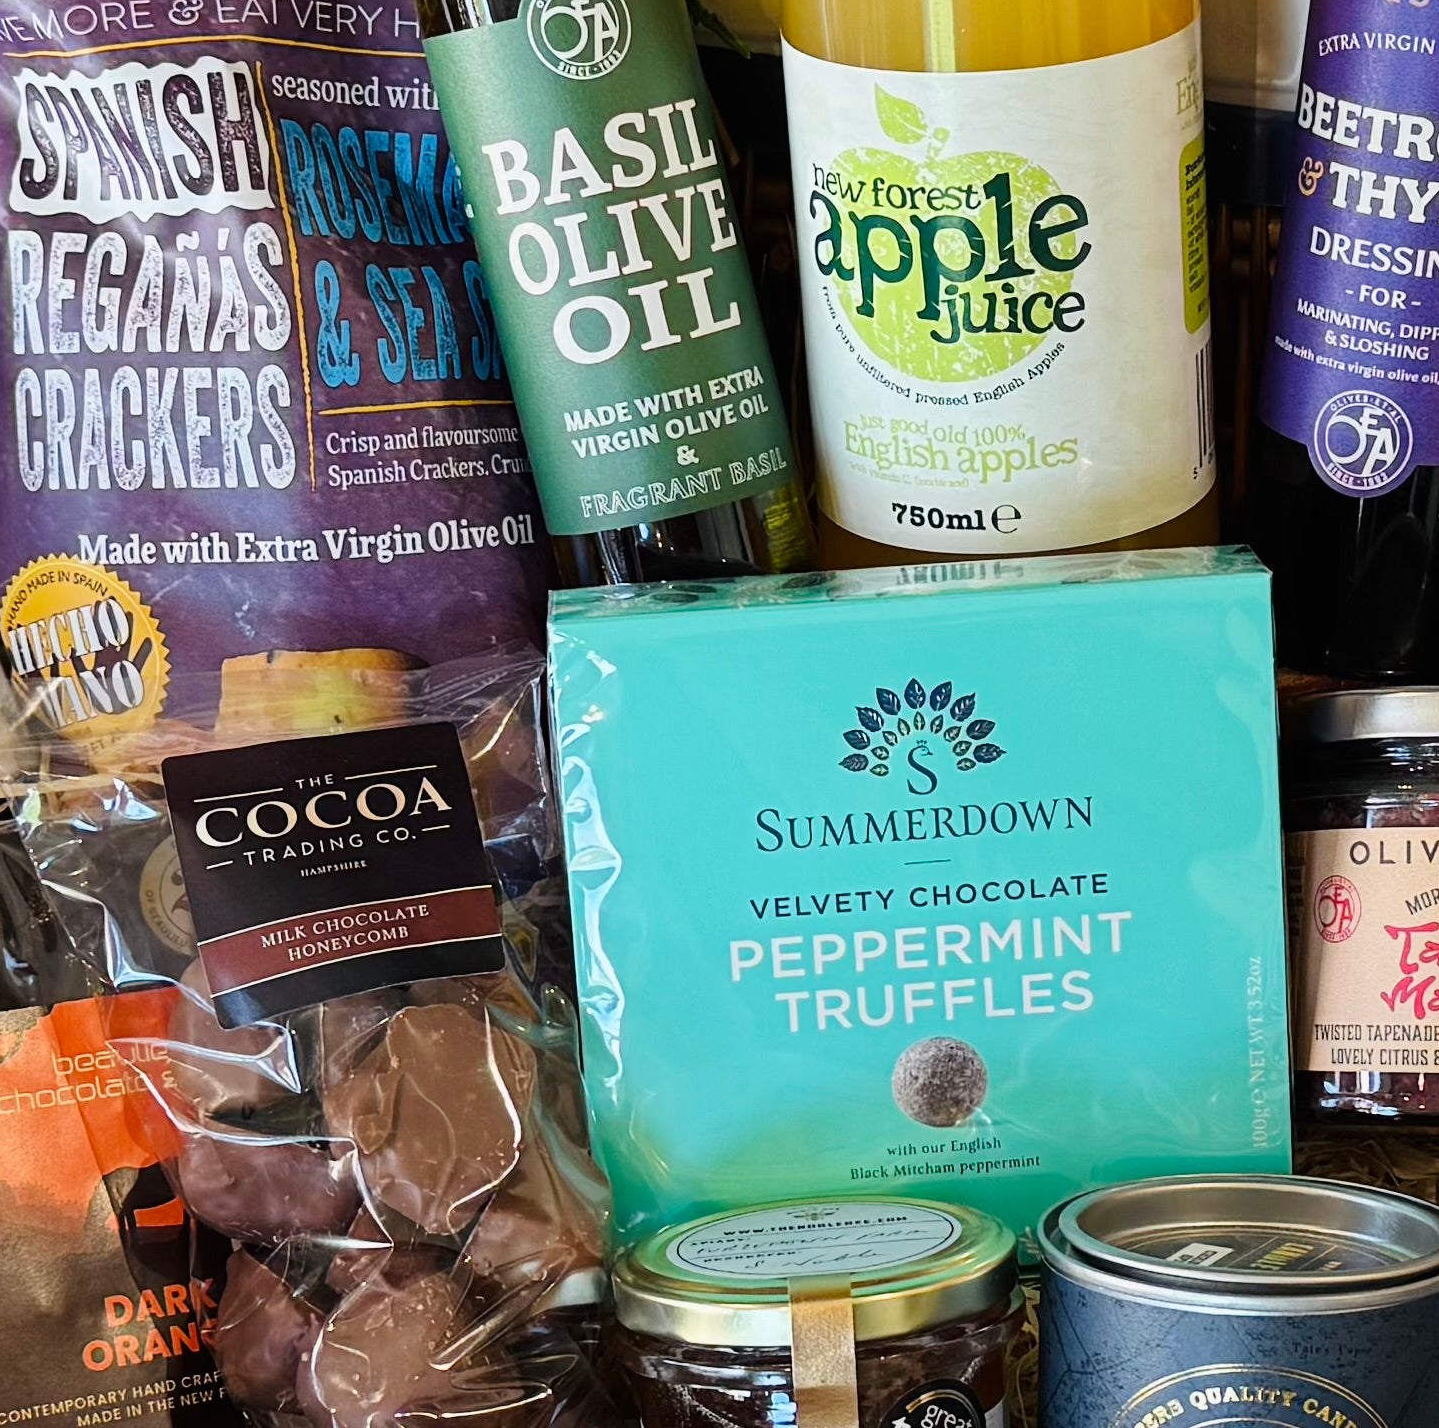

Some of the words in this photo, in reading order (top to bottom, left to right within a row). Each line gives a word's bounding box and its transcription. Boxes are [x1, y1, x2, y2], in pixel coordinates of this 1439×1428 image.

[1319, 35, 1361, 57] EXTRA
[1364, 33, 1436, 55] VIRGIN
[19, 71, 263, 203] SPANISH
[481, 98, 718, 216] BASIL
[1297, 156, 1324, 197] &
[507, 178, 738, 296] OLIVE
[809, 172, 1092, 320] apple
[551, 266, 741, 364] OIL
[930, 282, 1086, 343] juice
[1297, 298, 1395, 338] MARINATING,
[16, 363, 296, 494] CRACKERS
[572, 424, 659, 459] VIRGIN
[665, 410, 735, 441] OLIVE
[739, 397, 769, 427] OIL
[78, 530, 155, 565] Made
[162, 533, 230, 565] with
[235, 527, 318, 565] Extra
[323, 523, 425, 564] Virgin
[428, 518, 496, 554] Olive
[501, 512, 535, 549] Oil
[892, 502, 987, 531] 750ml
[755, 796, 1094, 853] SUMMERDOWN
[749, 888, 895, 920] VELVETY
[909, 872, 1110, 909] CHOCOLATE
[260, 924, 306, 948] MILK
[313, 904, 430, 933] CHOCOLATE
[288, 925, 410, 962] HONEYCOMB
[729, 910, 1133, 983] PEPPERMINT
[774, 968, 1096, 1033] TRUFFLES
[1330, 1048, 1375, 1066] LOVELY
[1379, 1049, 1428, 1066] CITRUS
[131, 1379, 174, 1397] HAND
